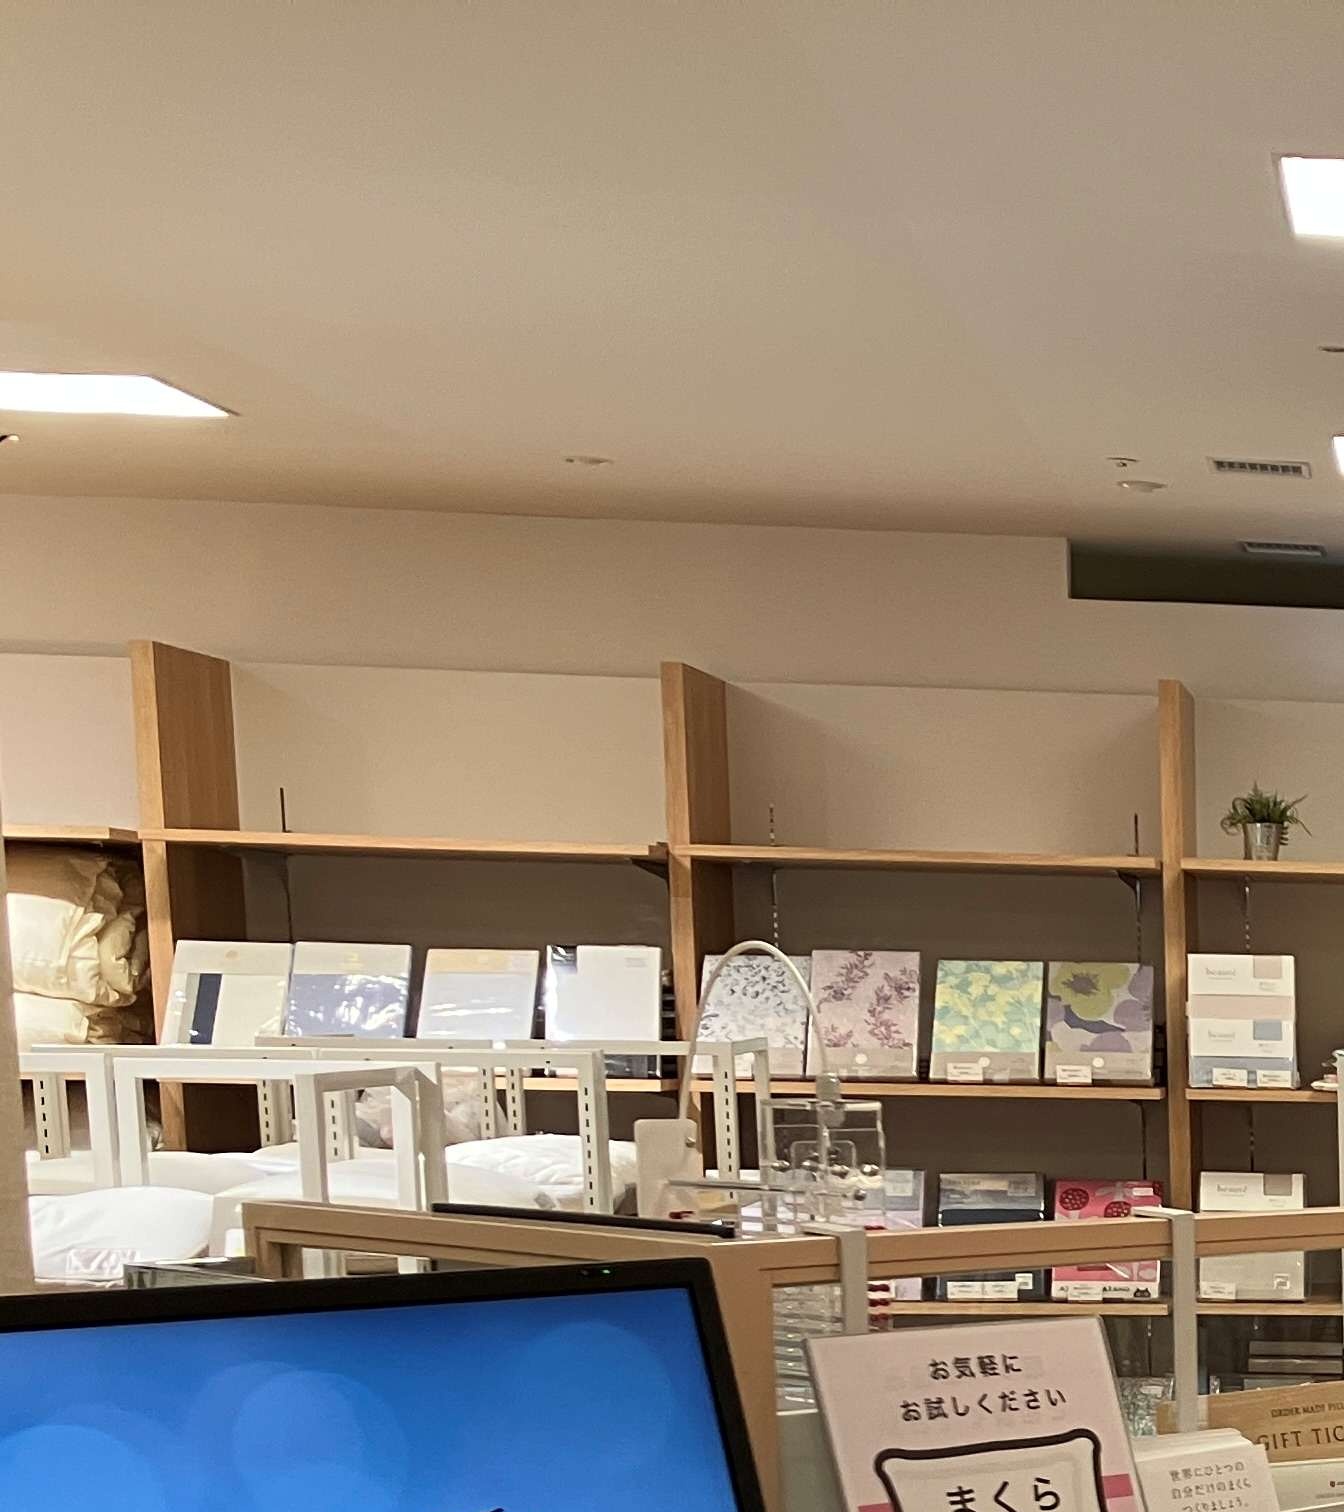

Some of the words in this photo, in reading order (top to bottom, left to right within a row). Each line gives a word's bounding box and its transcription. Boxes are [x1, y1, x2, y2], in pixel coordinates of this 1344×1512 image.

[928, 1353, 1022, 1380] お気軽に
[900, 1389, 1067, 1422] お試しください
[1256, 1430, 1303, 1451] GIFT
